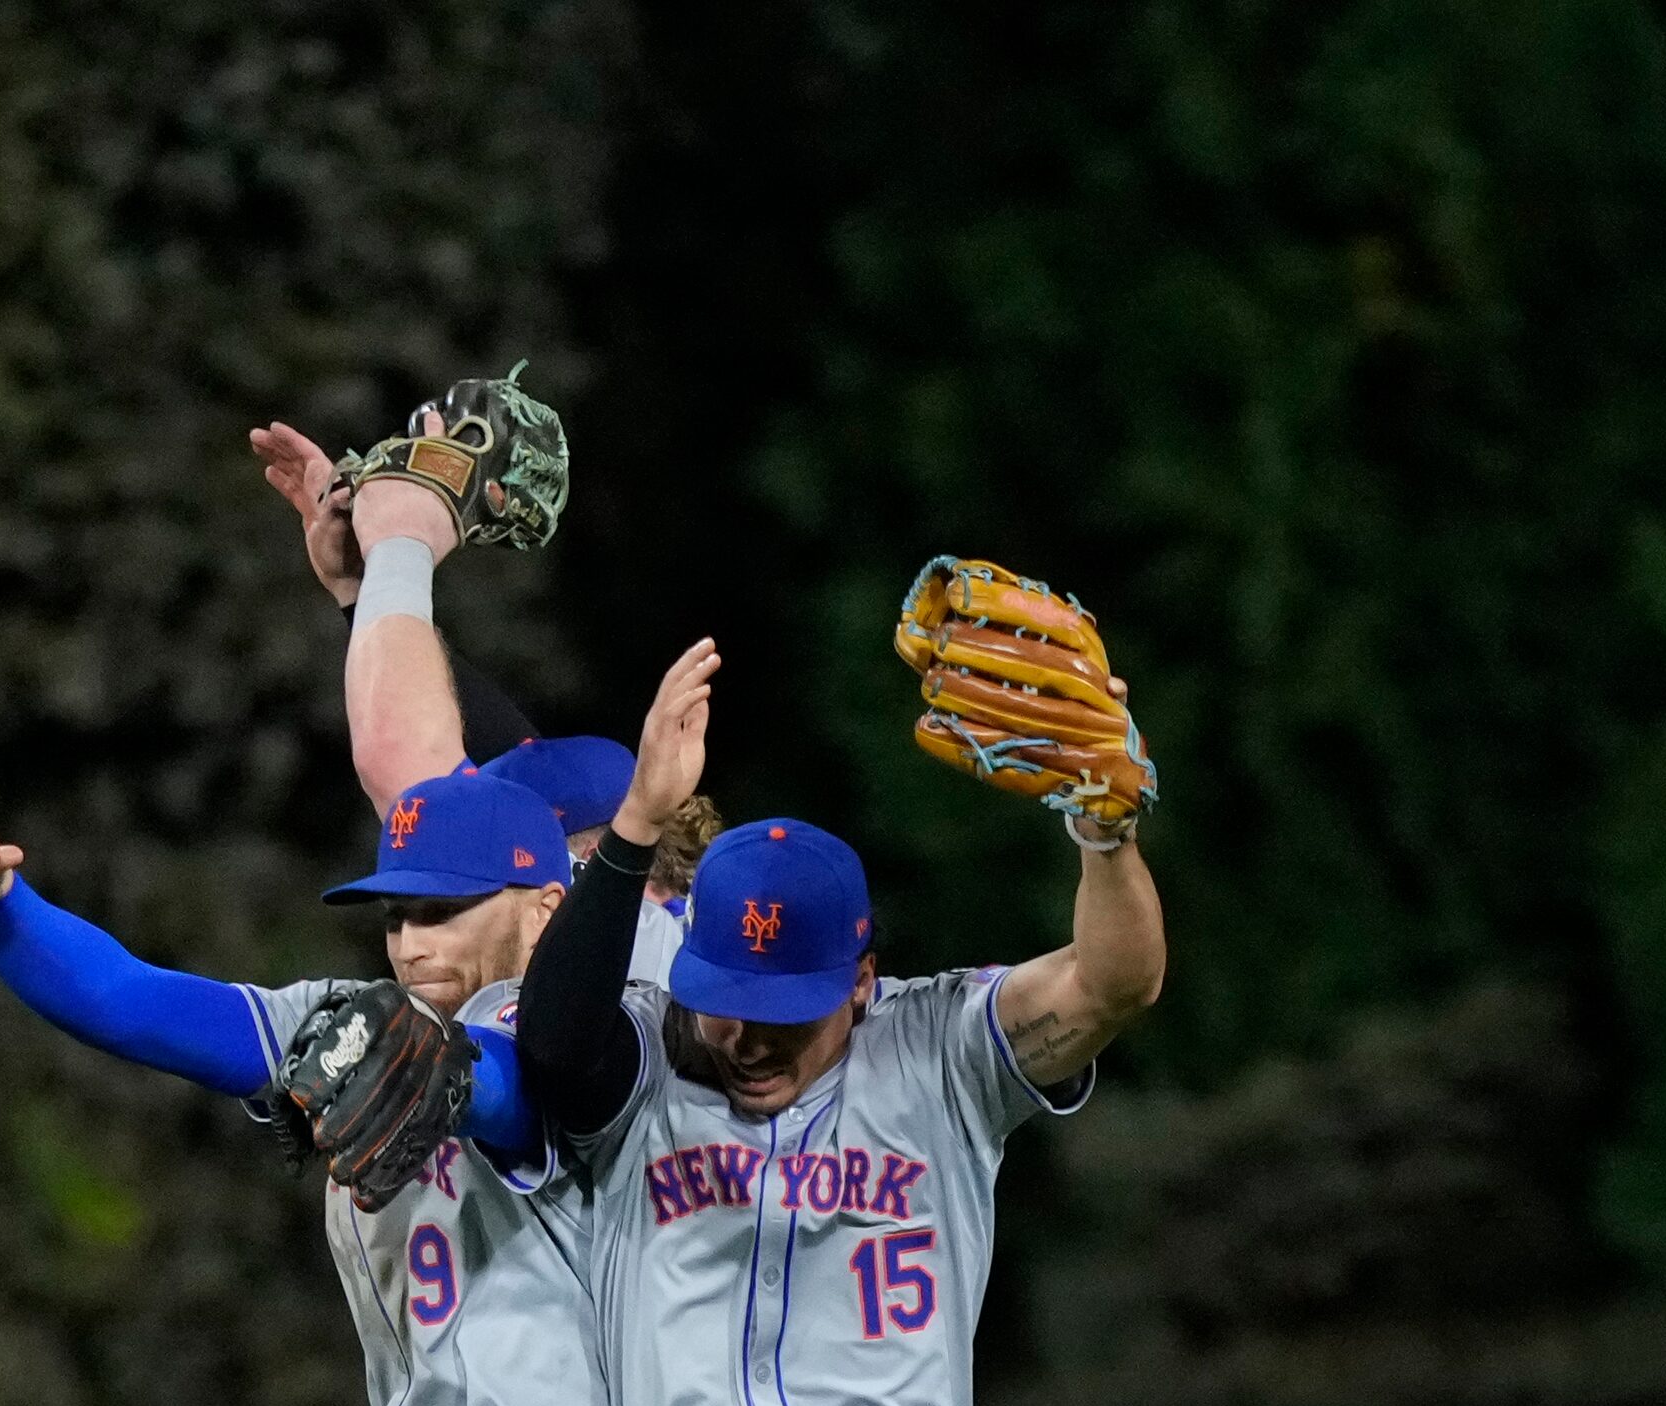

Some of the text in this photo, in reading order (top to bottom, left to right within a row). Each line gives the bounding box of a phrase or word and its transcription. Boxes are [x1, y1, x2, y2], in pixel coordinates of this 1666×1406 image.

[646, 1143, 927, 1226] NEW YORK
[408, 1223, 459, 1327] 9
[849, 1229, 937, 1340] 15
